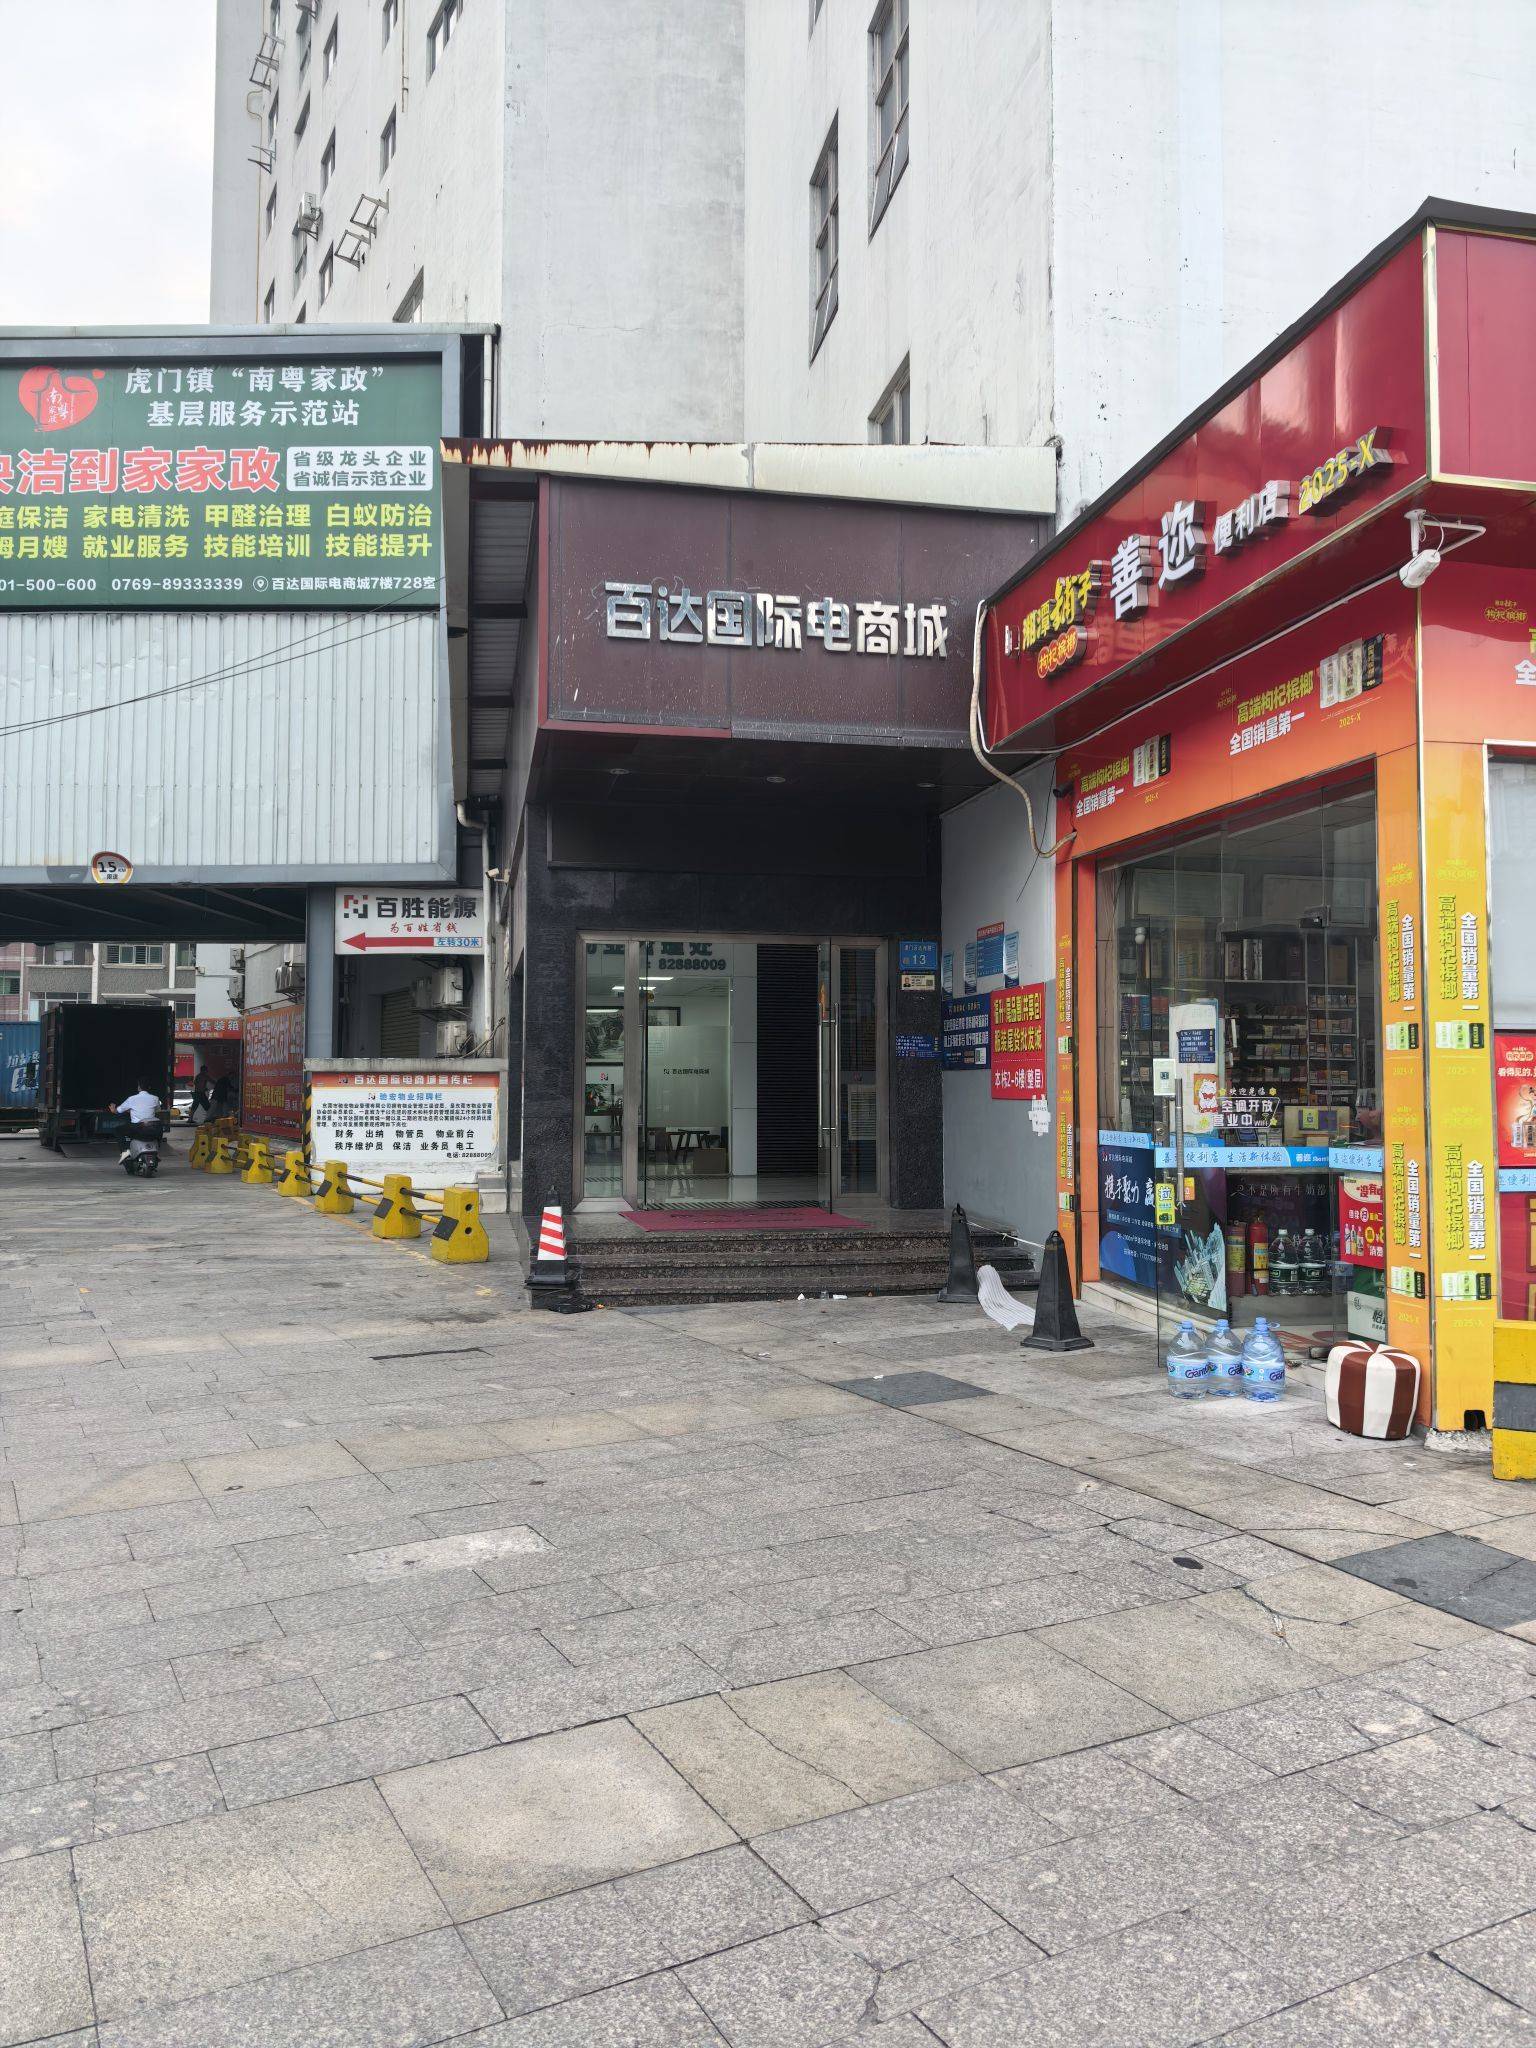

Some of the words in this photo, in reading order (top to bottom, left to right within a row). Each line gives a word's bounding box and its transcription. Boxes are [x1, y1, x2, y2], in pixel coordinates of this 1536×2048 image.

[147, 400, 360, 427] 基层服务示范站
[293, 450, 427, 467] 省级龙头企业
[293, 470, 427, 487] 省诚信示范企业
[1299, 430, 1377, 514] 2025-X
[83, 504, 190, 528] 家电清洗
[204, 504, 312, 528] 甲醛治理
[326, 503, 433, 527] 白蚁防治
[1213, 480, 1279, 555] 便利店
[83, 535, 190, 559] 就业服务
[204, 534, 312, 558] 技能培训
[325, 533, 433, 558] 技能提升
[112, 577, 243, 592] 0769-89333339
[272, 576, 436, 591] 百达国际电商城7楼728室
[604, 581, 949, 657] 百达国际电商城
[1038, 627, 1079, 675] 枸杞槟榔
[1237, 670, 1314, 725] 高端枸杞槟榔
[1229, 709, 1305, 756] 全国销量第一
[1076, 786, 1125, 818] 全国销量第一
[98, 862, 117, 873] 15
[375, 896, 477, 918] 百胜能源
[390, 921, 459, 934] 为百姓省钱
[437, 937, 480, 947] 左转30米
[1401, 913, 1415, 1011] 全国销量第一
[1460, 911, 1479, 1010] 全国销量第一
[1221, 1100, 1274, 1113] 空调开放
[335, 1129, 354, 1138] 财务
[365, 1129, 384, 1138] 出纳
[395, 1129, 424, 1138] 物管员
[436, 1129, 475, 1138] 物业前台
[1213, 1115, 1253, 1127] 营业中
[335, 1141, 383, 1151] 秩序维护员
[392, 1141, 412, 1151] 保洁
[420, 1141, 449, 1151] 业务员
[456, 1141, 475, 1151] 电工
[1162, 1151, 1219, 1164] 善便利店
[1407, 1159, 1422, 1258] 全国销量第一
[1467, 1159, 1486, 1260] 全国销量第一
